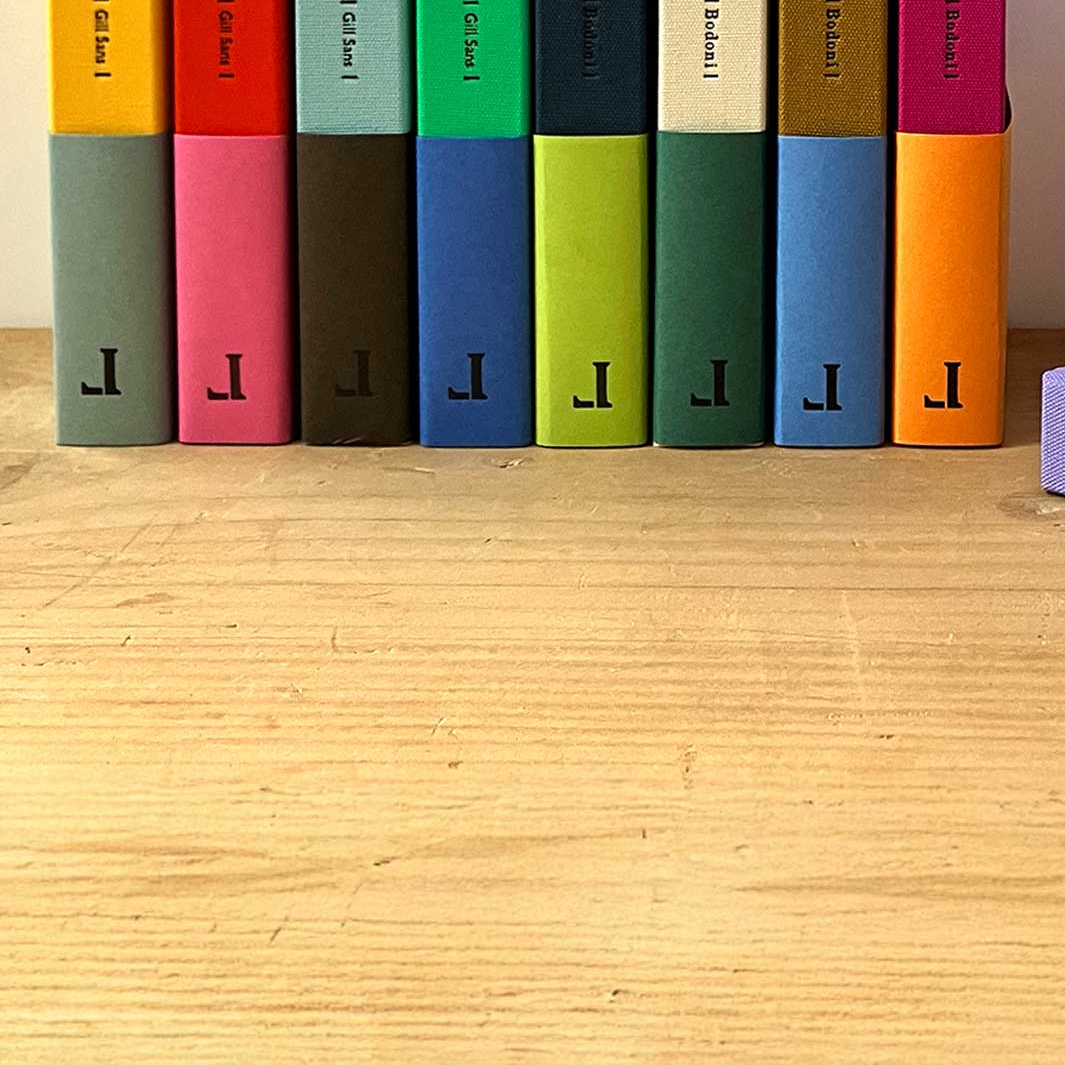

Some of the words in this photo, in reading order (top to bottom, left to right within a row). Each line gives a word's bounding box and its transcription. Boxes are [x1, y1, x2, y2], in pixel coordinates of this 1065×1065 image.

[94, 9, 109, 33] Gill
[219, 9, 234, 33] Gill
[342, 11, 357, 35] Gill
[464, 12, 480, 36] Gill
[95, 35, 110, 65] Sans
[219, 36, 235, 66] Sans
[342, 38, 357, 68] Sans
[703, 8, 720, 68] Bodoni
[824, 8, 842, 68] Bodoni
[944, 8, 961, 69] Bodoni
[464, 39, 480, 68] Sans
